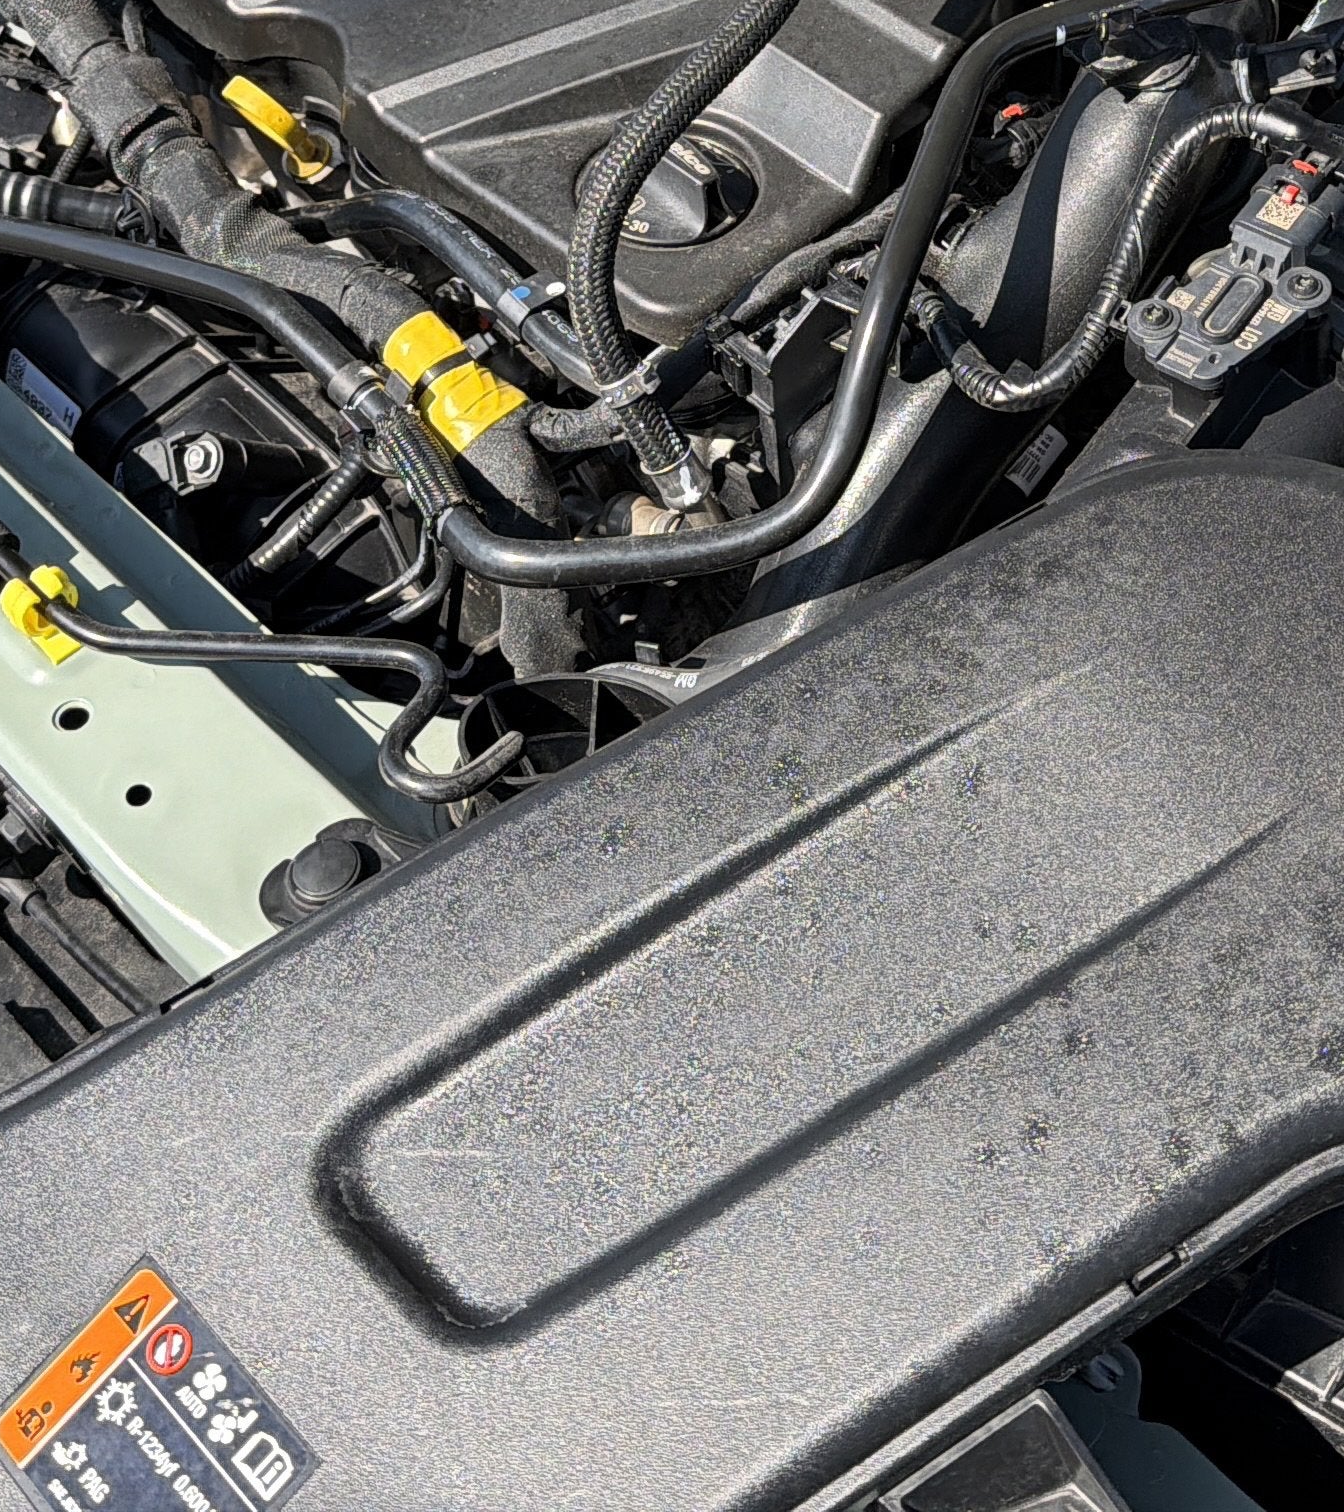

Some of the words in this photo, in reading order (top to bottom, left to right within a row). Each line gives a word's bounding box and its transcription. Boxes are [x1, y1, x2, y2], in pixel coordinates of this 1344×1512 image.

[174, 1385, 208, 1420] AUTO
[125, 1416, 181, 1478] R-1234yf
[78, 1467, 111, 1504] PAG
